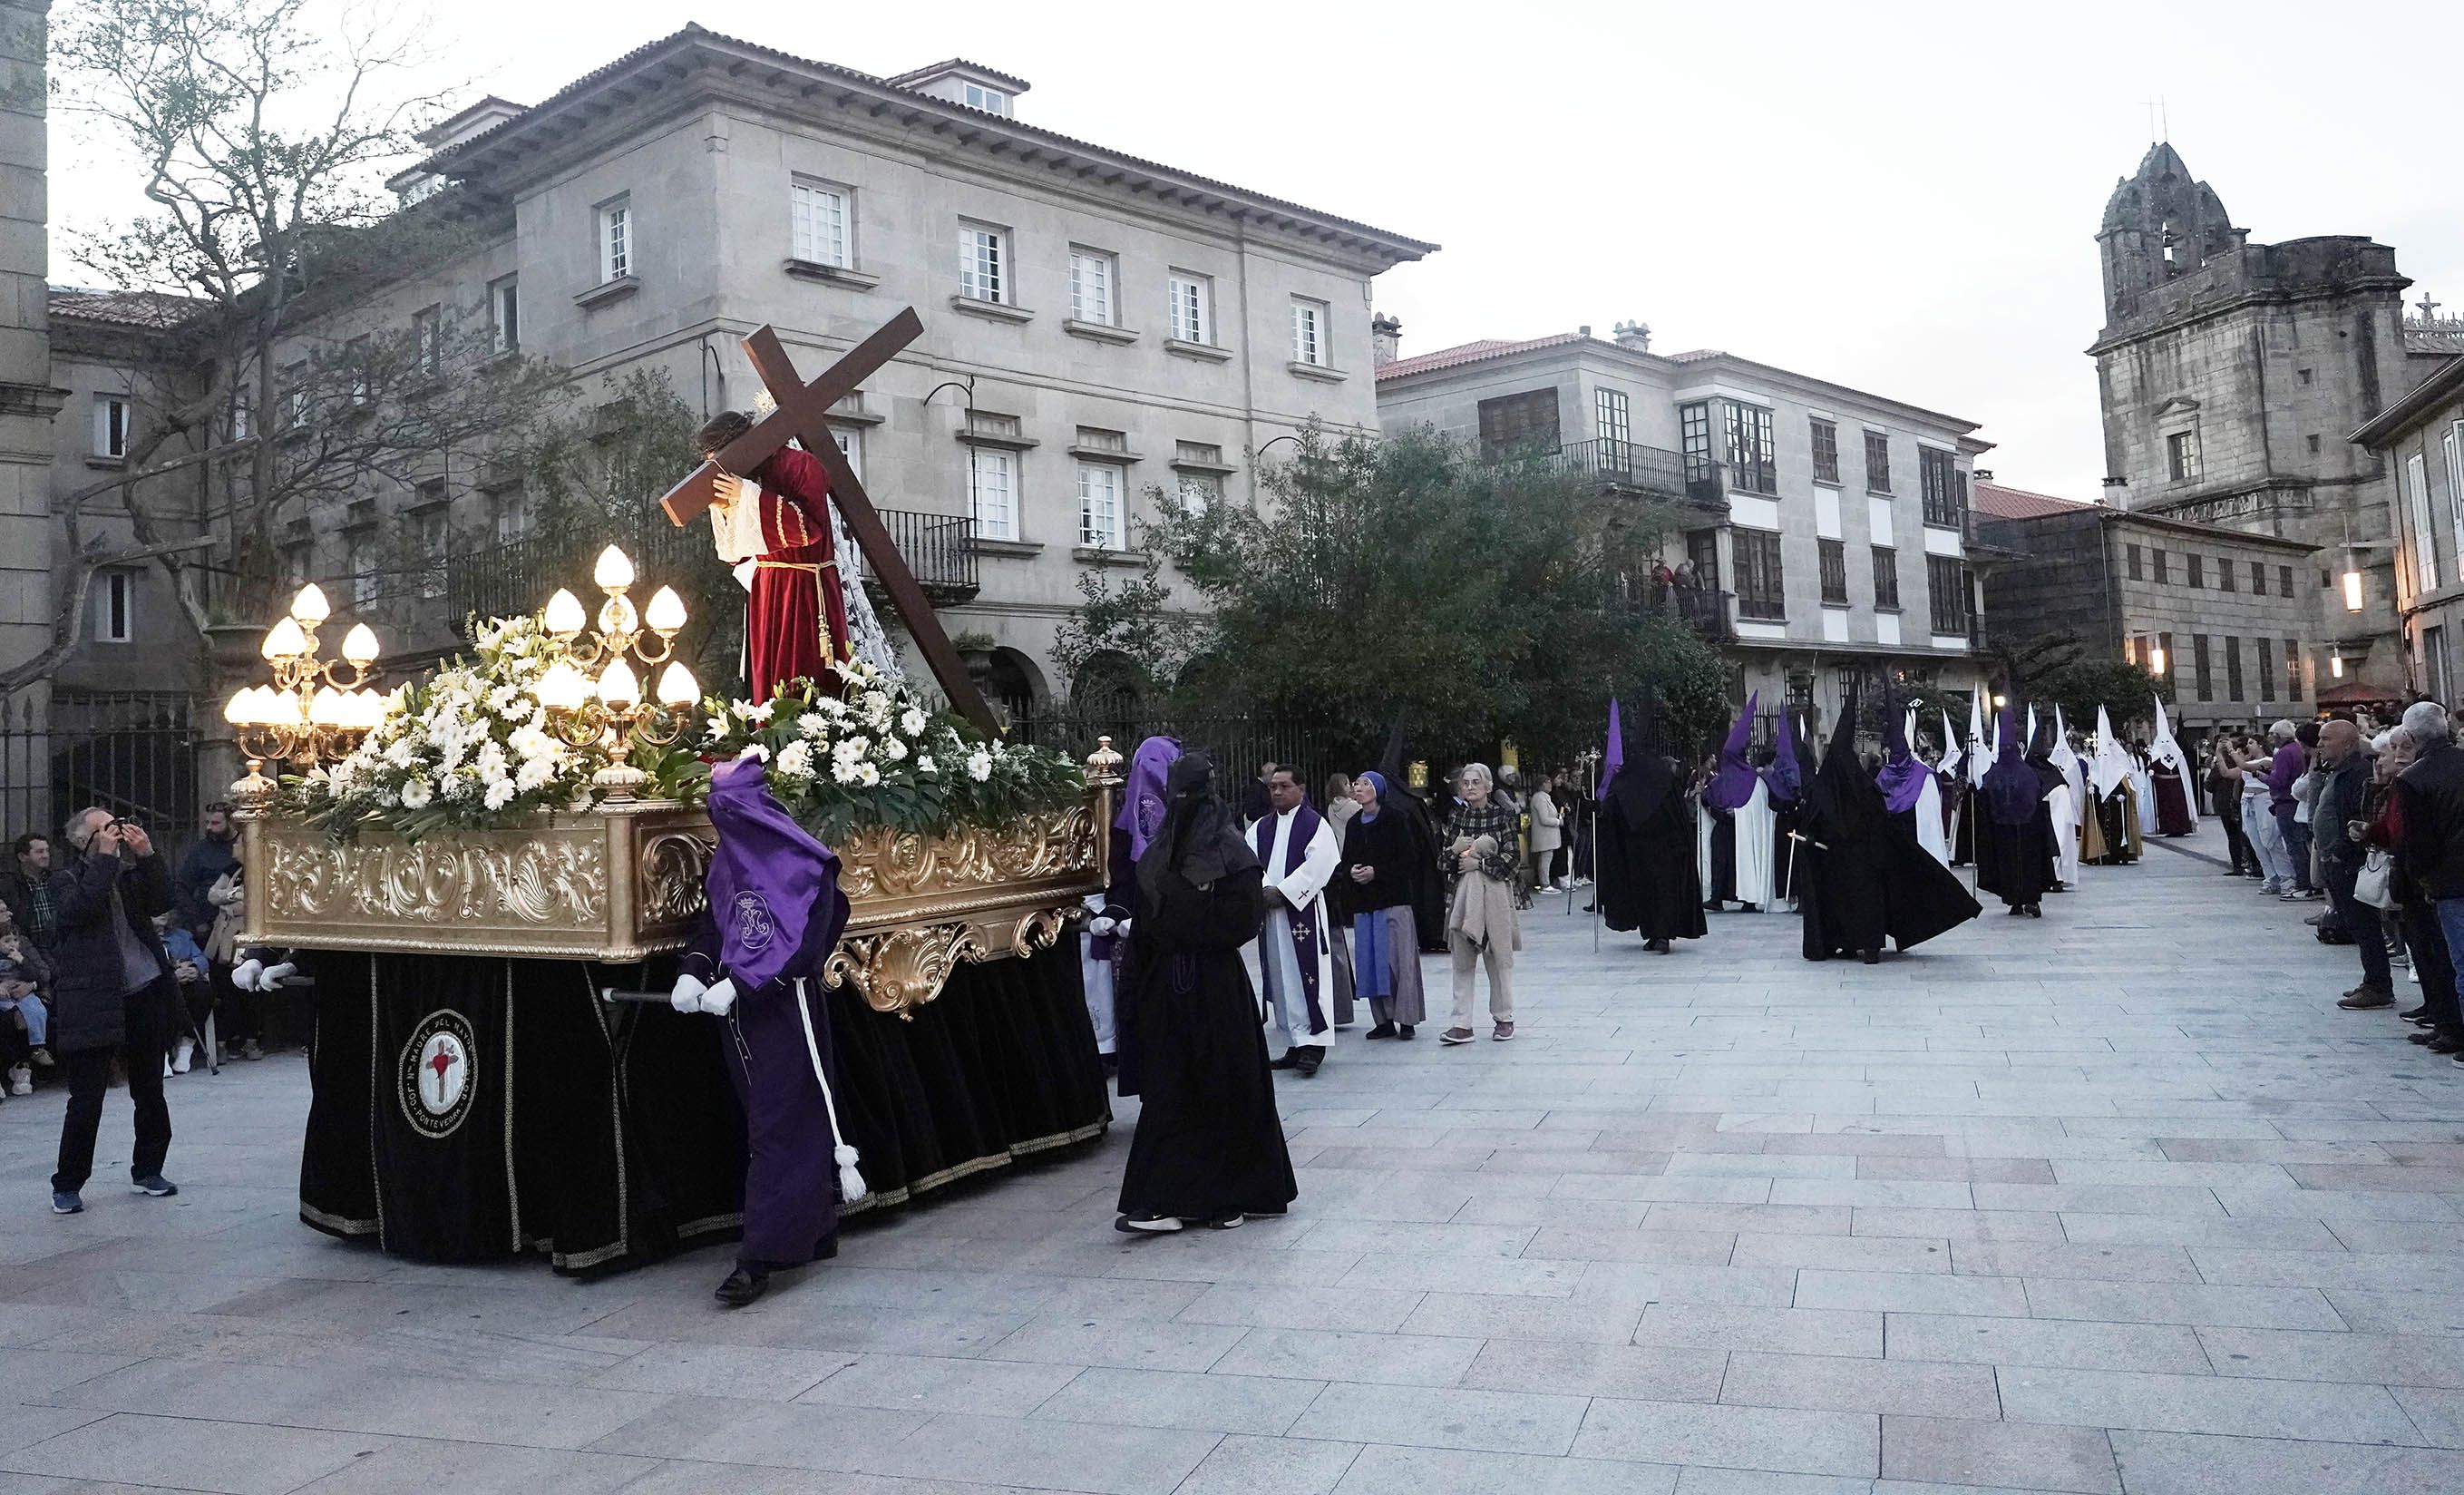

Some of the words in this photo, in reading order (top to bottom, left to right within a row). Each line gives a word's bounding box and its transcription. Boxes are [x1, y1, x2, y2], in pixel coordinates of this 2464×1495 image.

[410, 1027, 432, 1061] MADRE
[434, 1018, 450, 1029] DEL
[415, 1109, 461, 1129] PONTEVEDRA
